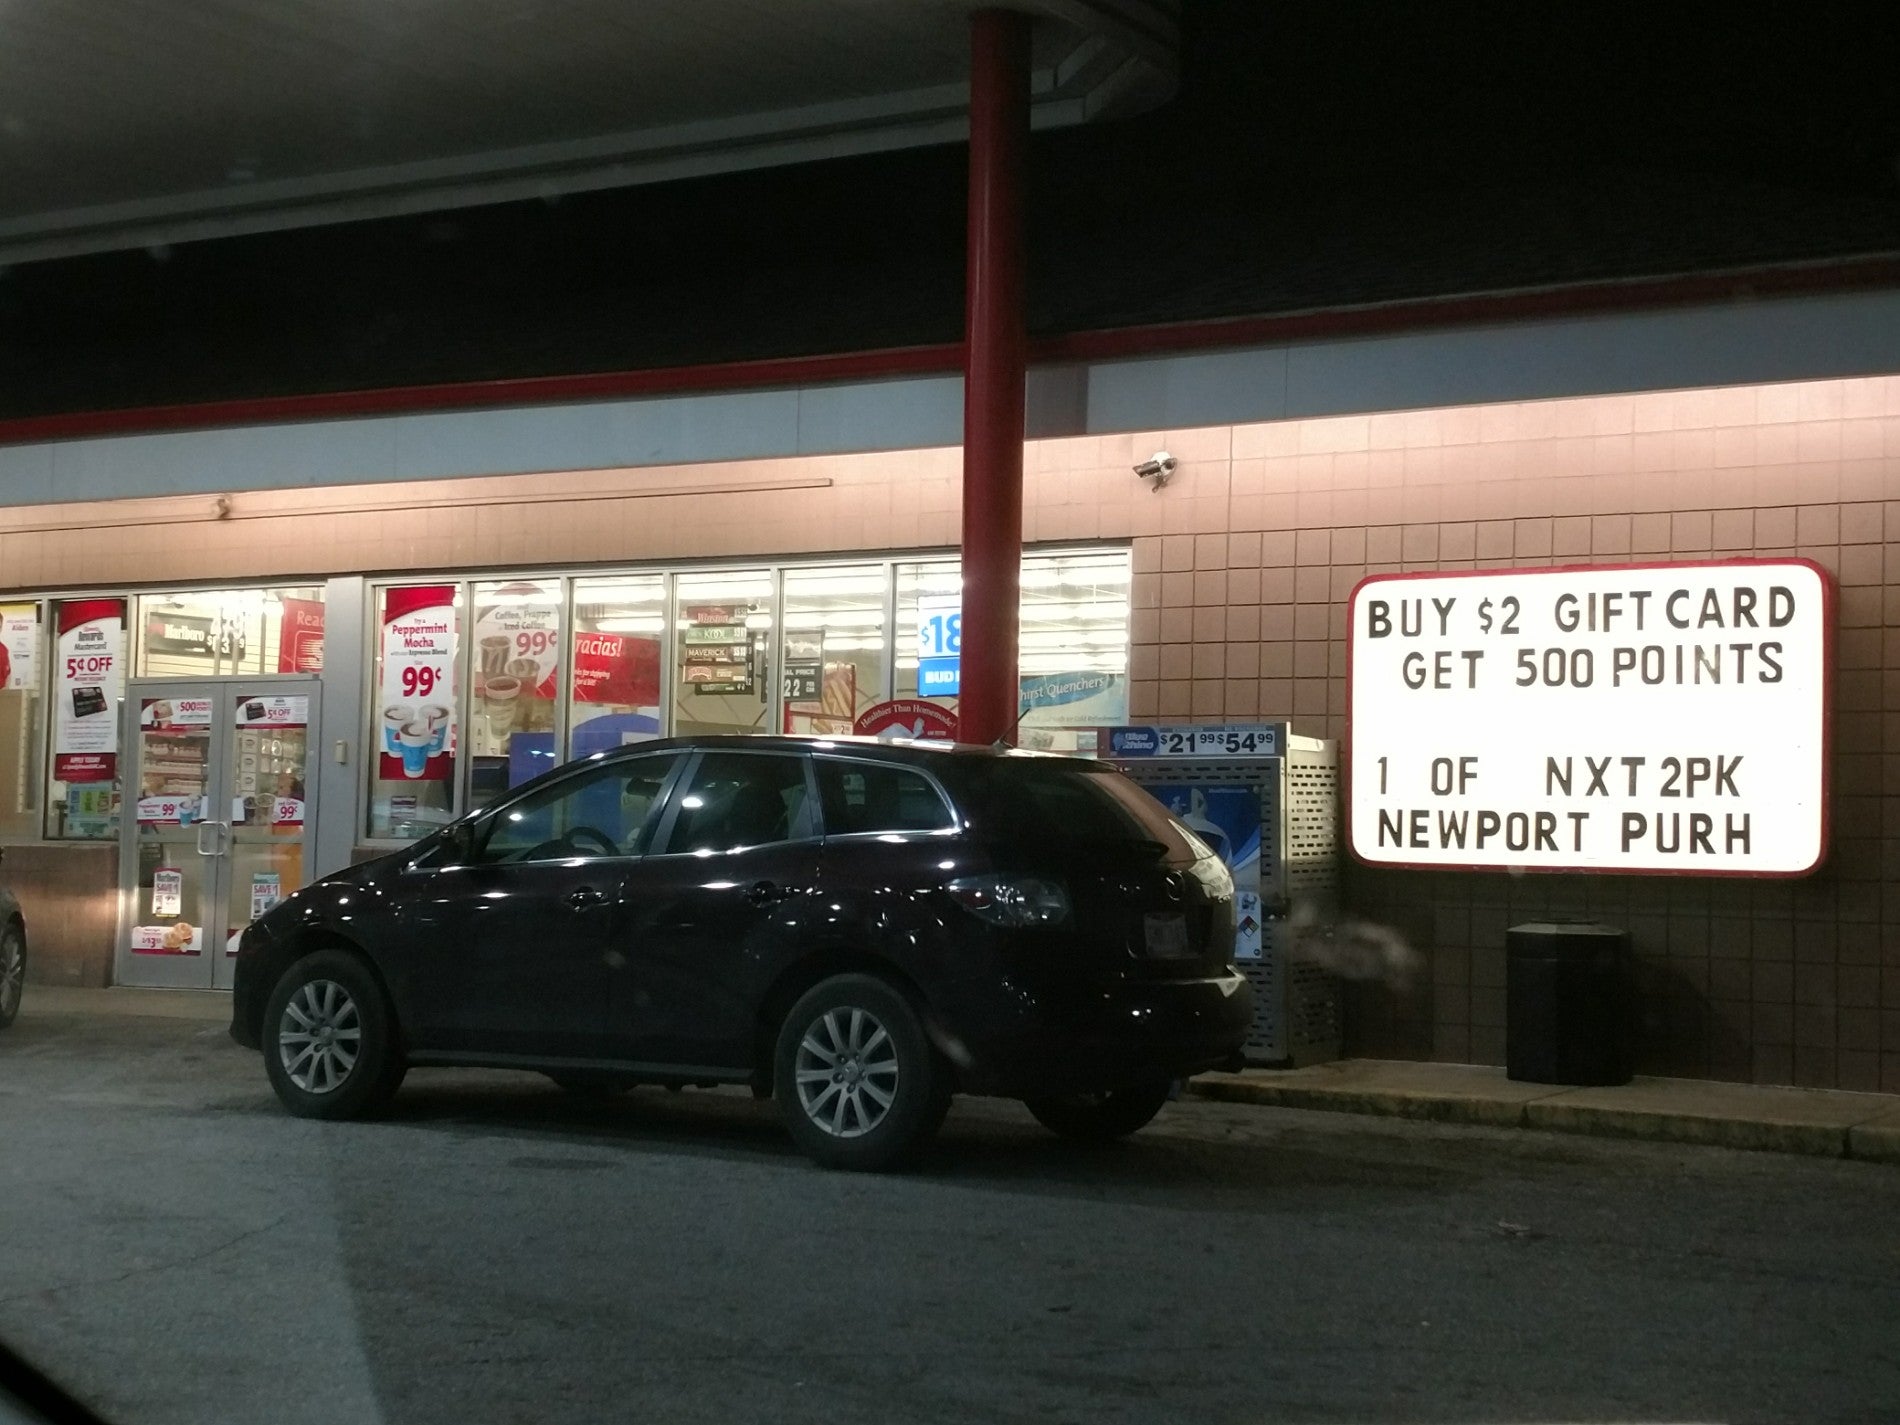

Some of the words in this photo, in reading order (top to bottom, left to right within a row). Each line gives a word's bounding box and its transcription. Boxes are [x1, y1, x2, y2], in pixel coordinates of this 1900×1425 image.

[1368, 597, 1456, 639] BUY
[1478, 595, 1521, 635] $2
[164, 622, 205, 642] Marlboro
[392, 622, 448, 638] Peppermint
[704, 627, 726, 640] KOOL
[404, 636, 435, 649] Mocha
[515, 630, 558, 657] 99¢
[575, 636, 623, 658] racias!
[688, 648, 725, 657] MAVERICK
[87, 656, 114, 673] OFF
[795, 668, 816, 677] PRICE
[1402, 649, 1485, 690] GET
[1516, 647, 1594, 689] 500
[1612, 641, 1784, 688] POINTS
[402, 666, 442, 698] 99¢
[925, 671, 954, 684] BUD
[1020, 686, 1045, 702] hirst
[1046, 676, 1105, 698] Quenchers
[180, 701, 197, 712] 500
[278, 708, 292, 717] OFF
[860, 706, 892, 729] Healthier
[892, 704, 912, 714] Than
[1124, 732, 1149, 742] Blue
[1122, 740, 1154, 751] Rhino
[1377, 756, 1389, 796] 1
[1431, 756, 1479, 797] OF
[1378, 807, 1590, 853] NEWPORT
[1620, 811, 1751, 855] PURH
[156, 882, 172, 893] SAVE
[254, 885, 271, 895] SAVE
